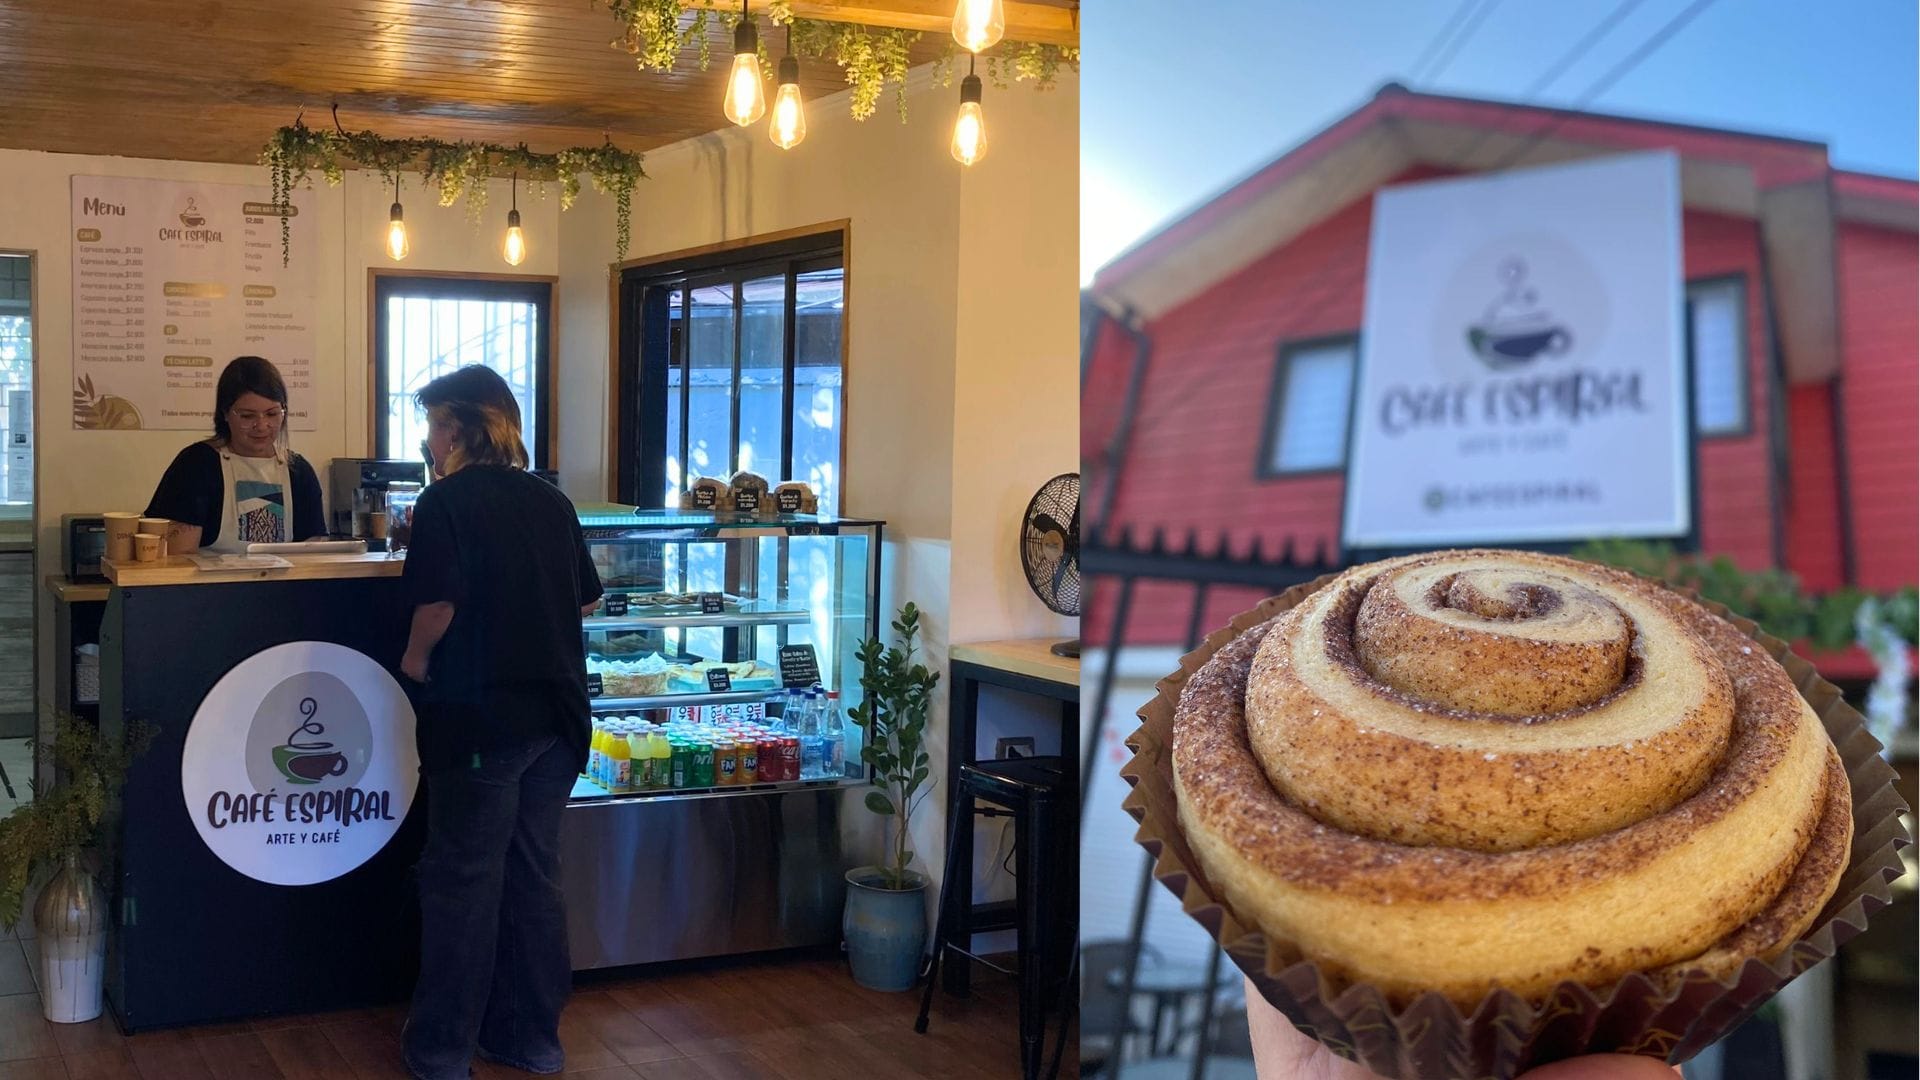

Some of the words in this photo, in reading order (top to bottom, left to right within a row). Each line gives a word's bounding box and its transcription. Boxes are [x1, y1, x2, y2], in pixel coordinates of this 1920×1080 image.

[83, 197, 125, 216] Menú
[185, 229, 223, 243] ESPIRAL
[1483, 369, 1649, 425] ESPIRAL
[721, 759, 737, 770] FAN
[743, 756, 758, 768] FAN
[207, 788, 278, 829] CAFÉ
[285, 786, 395, 828] ESPIRAL
[266, 833, 295, 845] ARTE
[300, 832, 308, 844] Y
[312, 829, 341, 843] CAFÉ
